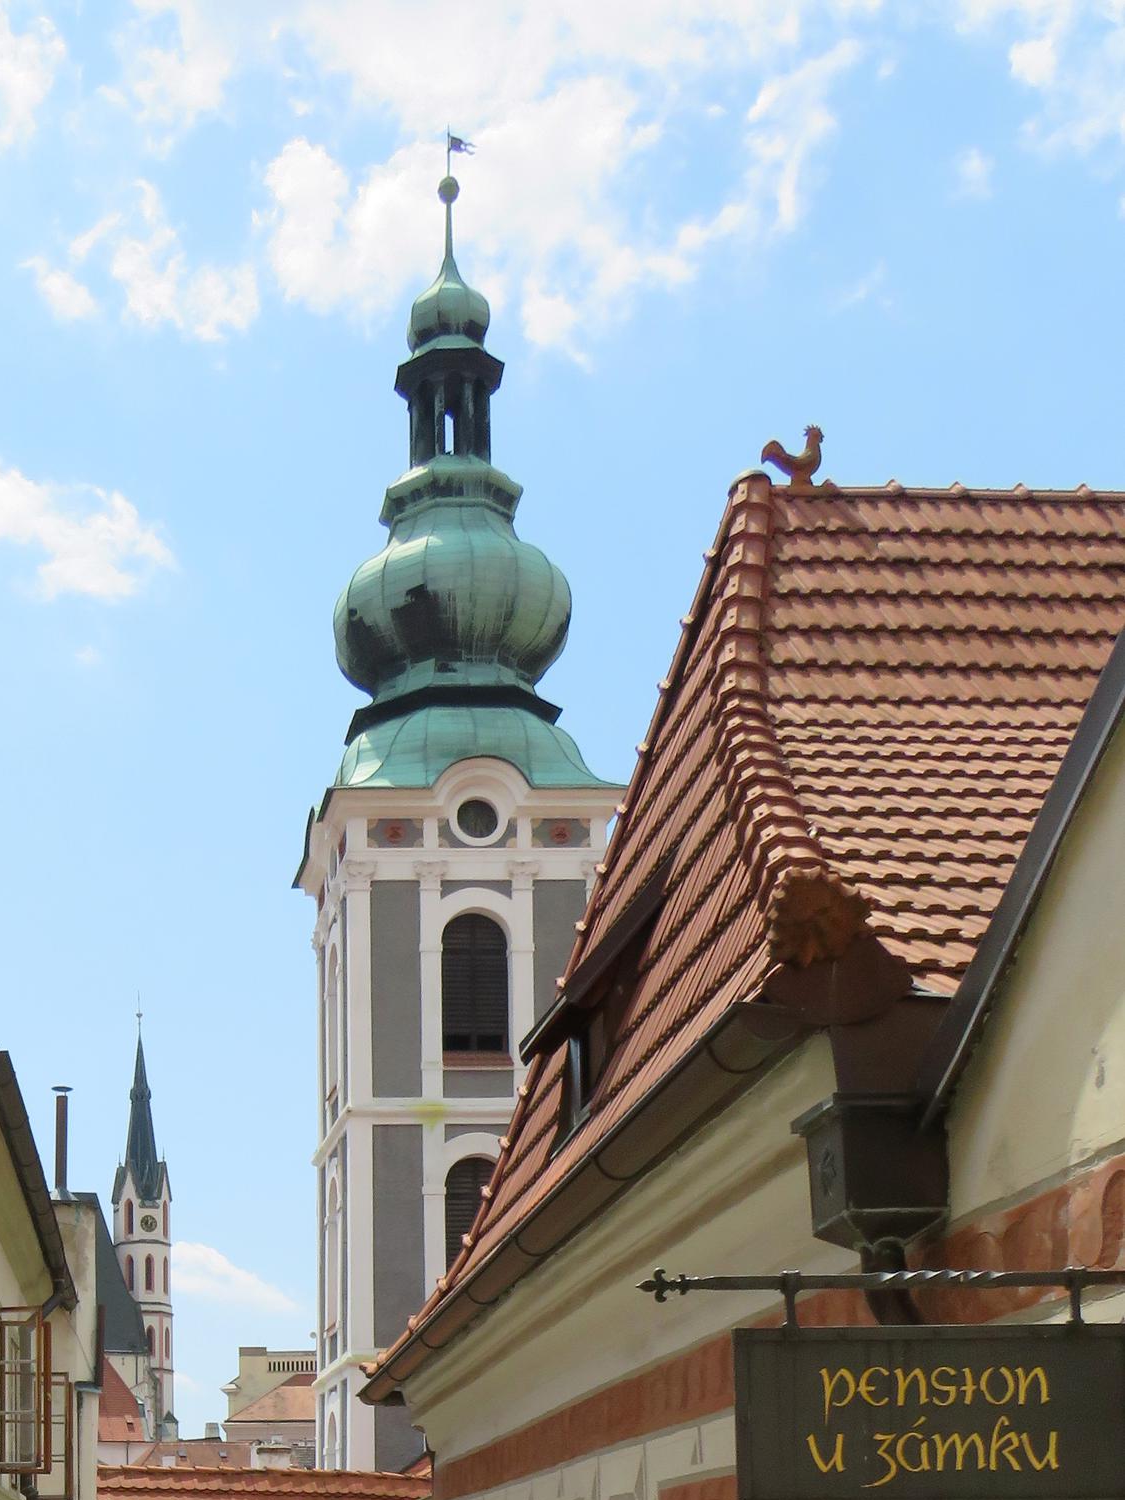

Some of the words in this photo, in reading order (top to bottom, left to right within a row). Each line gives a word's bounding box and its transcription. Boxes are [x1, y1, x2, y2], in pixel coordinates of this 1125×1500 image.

[819, 1365, 1050, 1425] pension
[806, 1431, 847, 1474] u
[860, 1414, 1060, 1488] zámku
